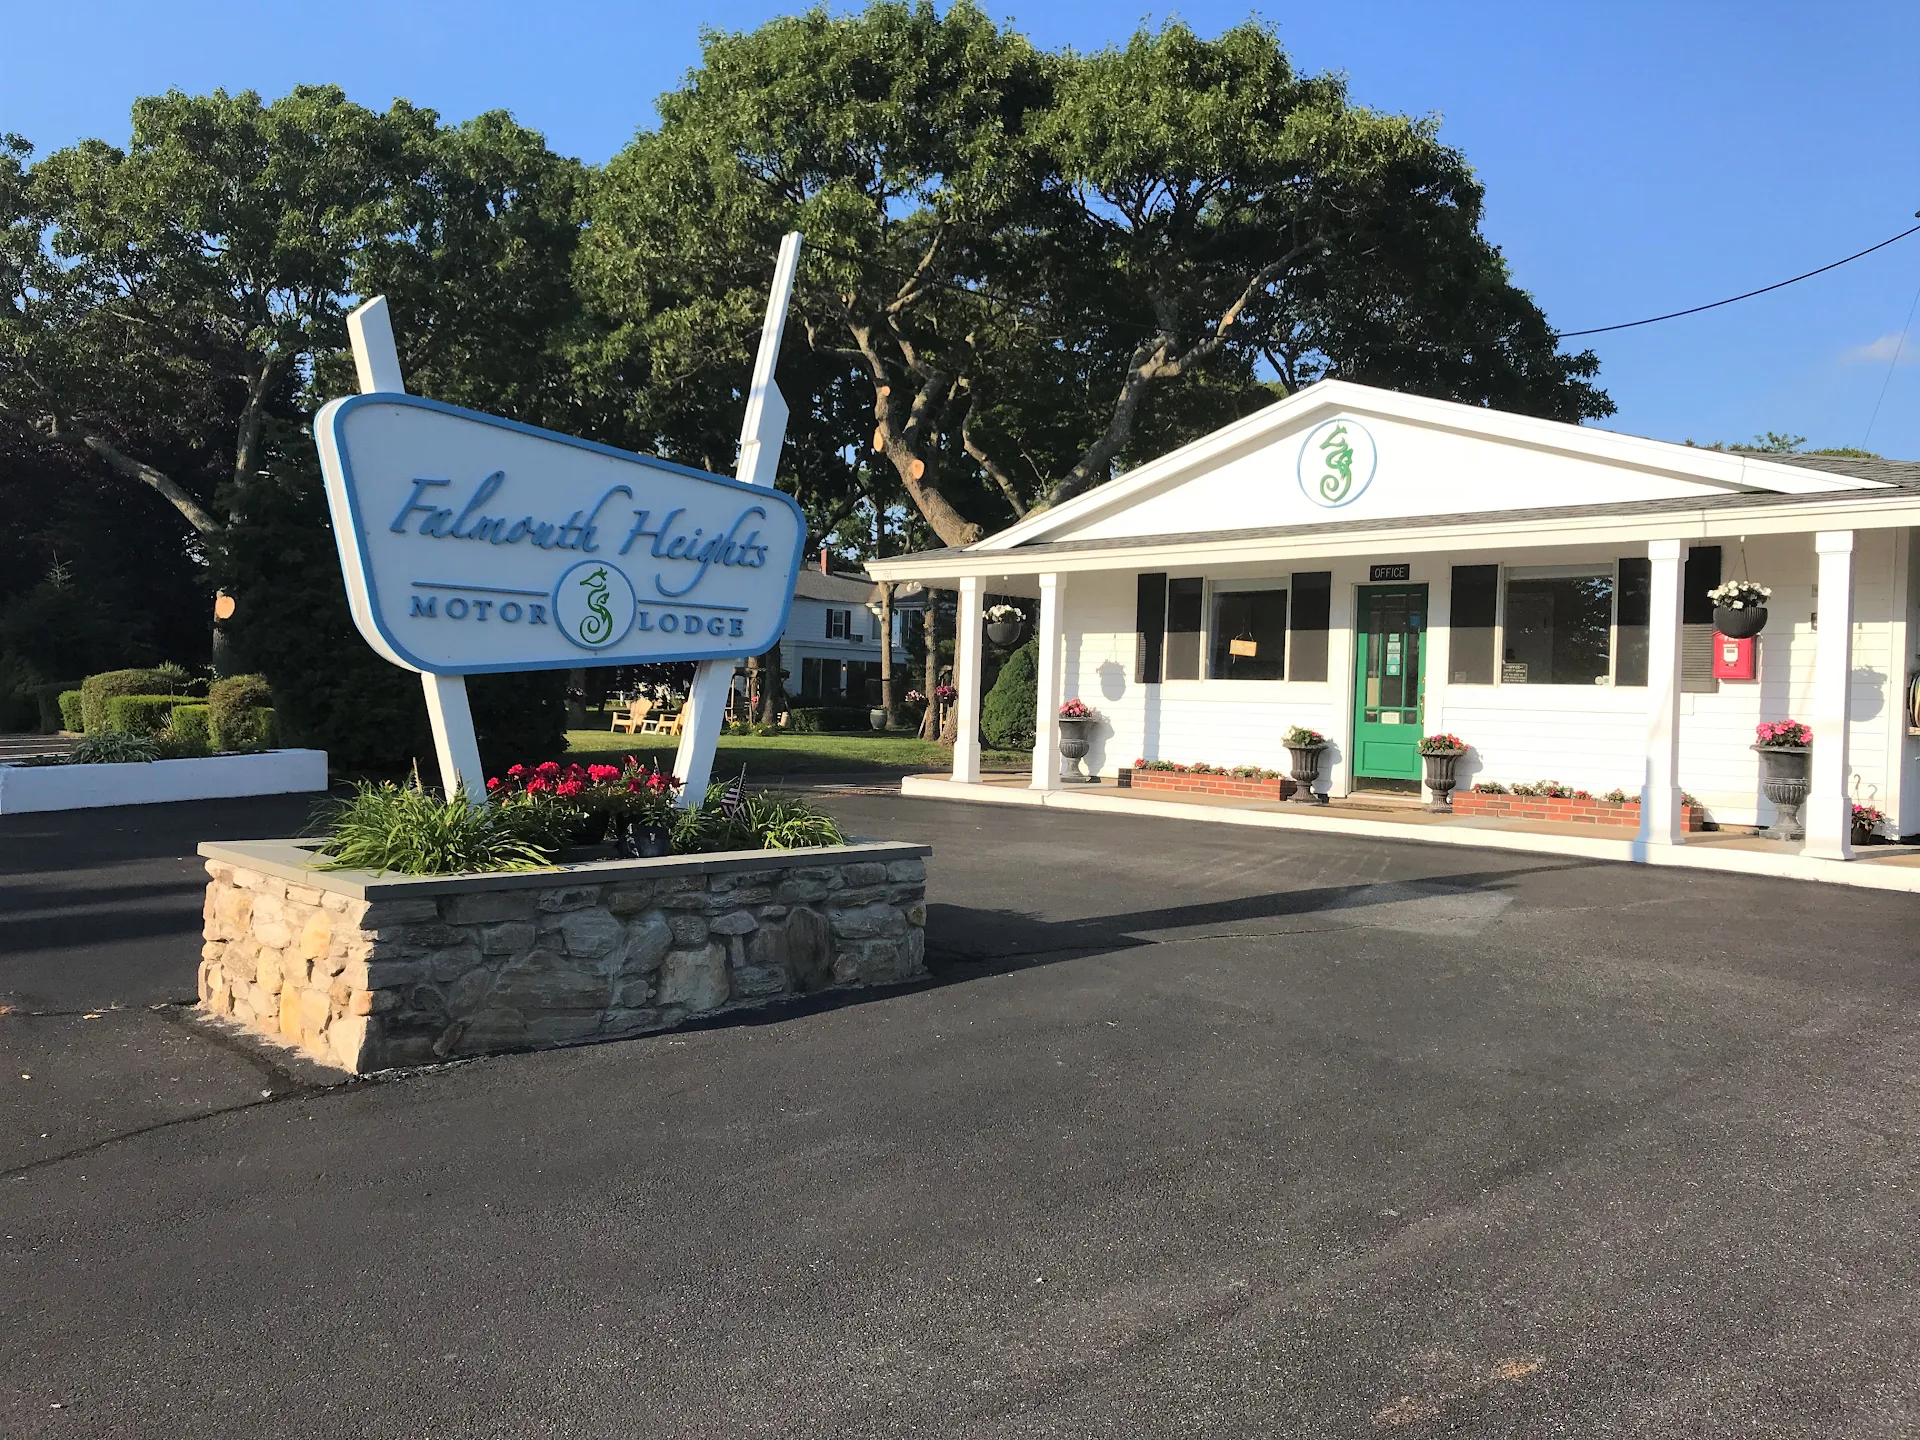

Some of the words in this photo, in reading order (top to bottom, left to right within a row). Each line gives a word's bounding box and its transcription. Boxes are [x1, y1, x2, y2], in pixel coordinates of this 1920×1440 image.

[389, 470, 633, 553] Falmouth
[618, 506, 769, 598] Heights
[1374, 567, 1405, 578] OFFICE
[409, 595, 548, 625] MOTOR
[638, 611, 745, 638] LODGE
